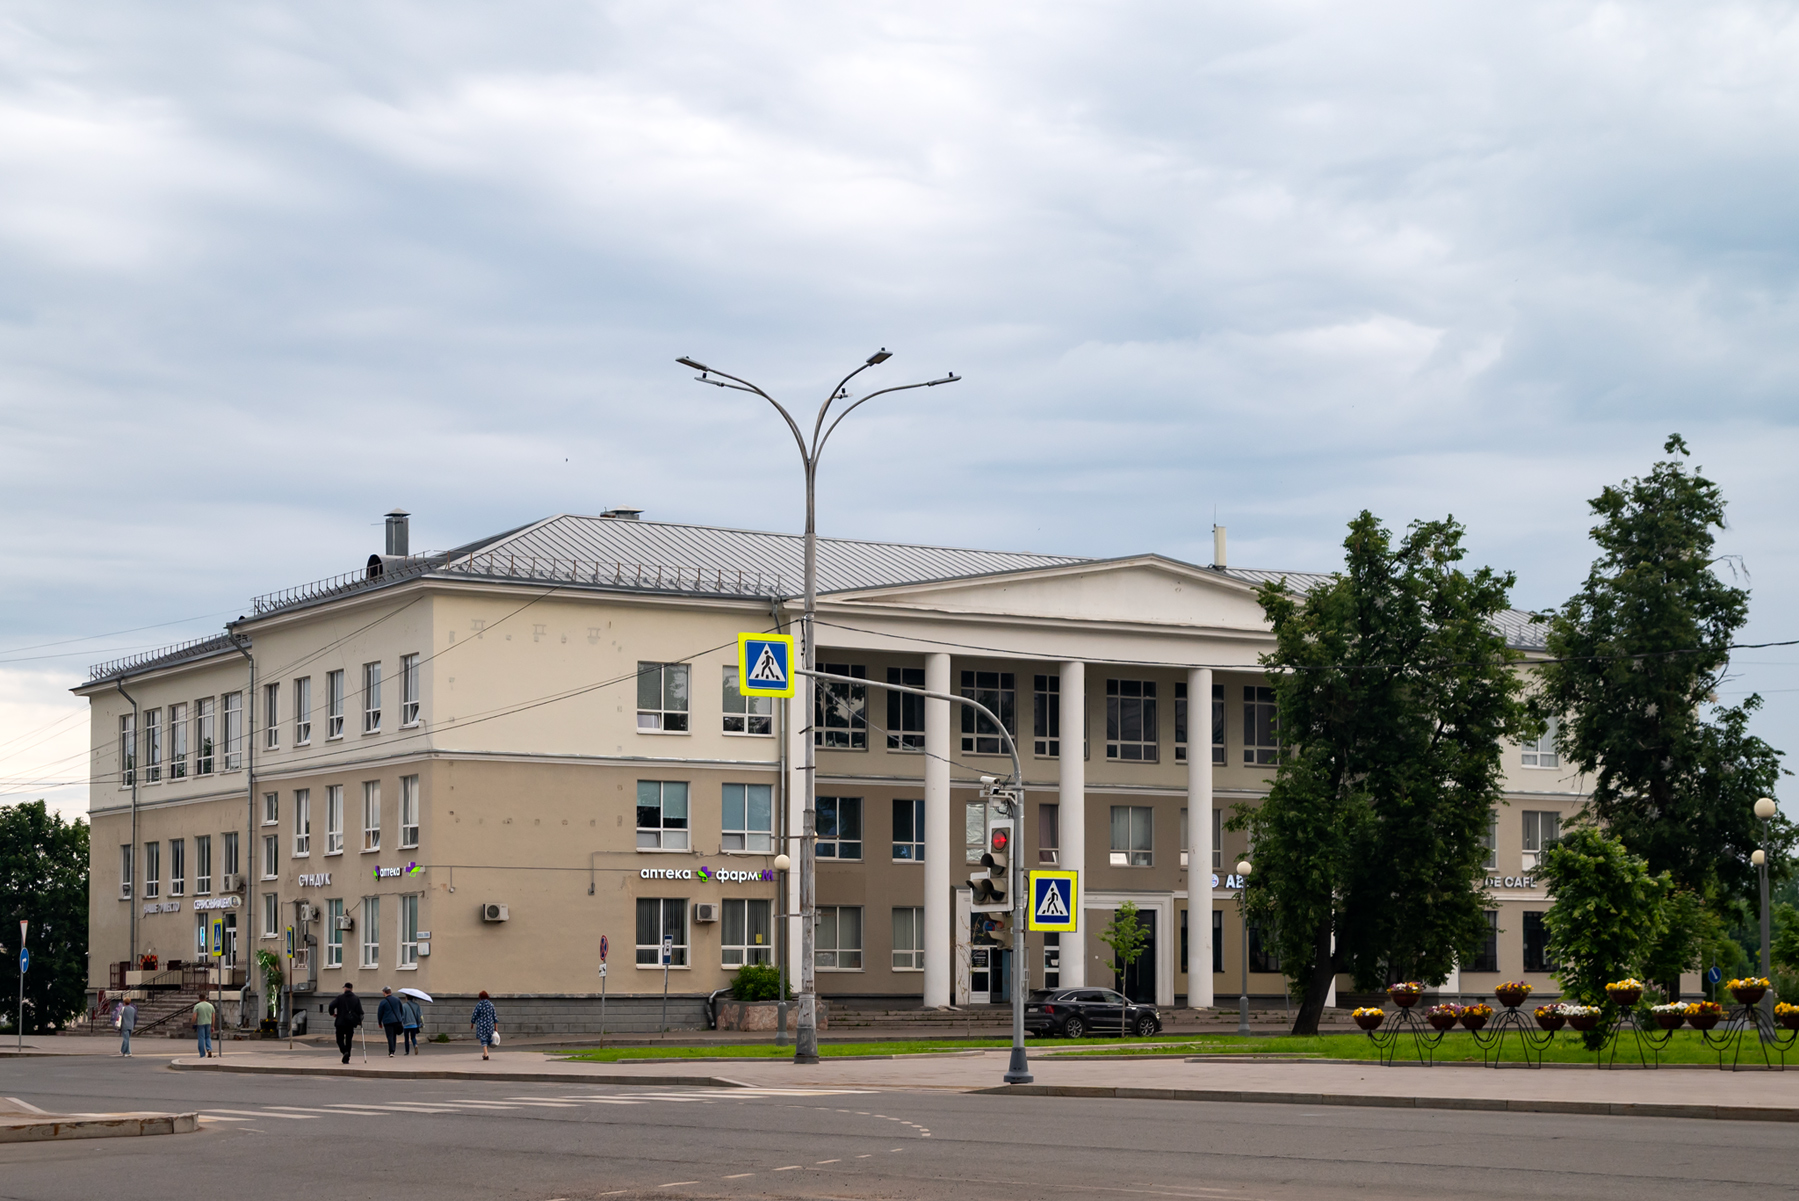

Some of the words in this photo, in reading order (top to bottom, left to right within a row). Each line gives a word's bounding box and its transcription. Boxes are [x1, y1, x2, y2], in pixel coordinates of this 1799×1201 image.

[380, 867, 401, 877] аптека
[640, 868, 692, 879] аптека
[298, 873, 331, 887] СУНДУК
